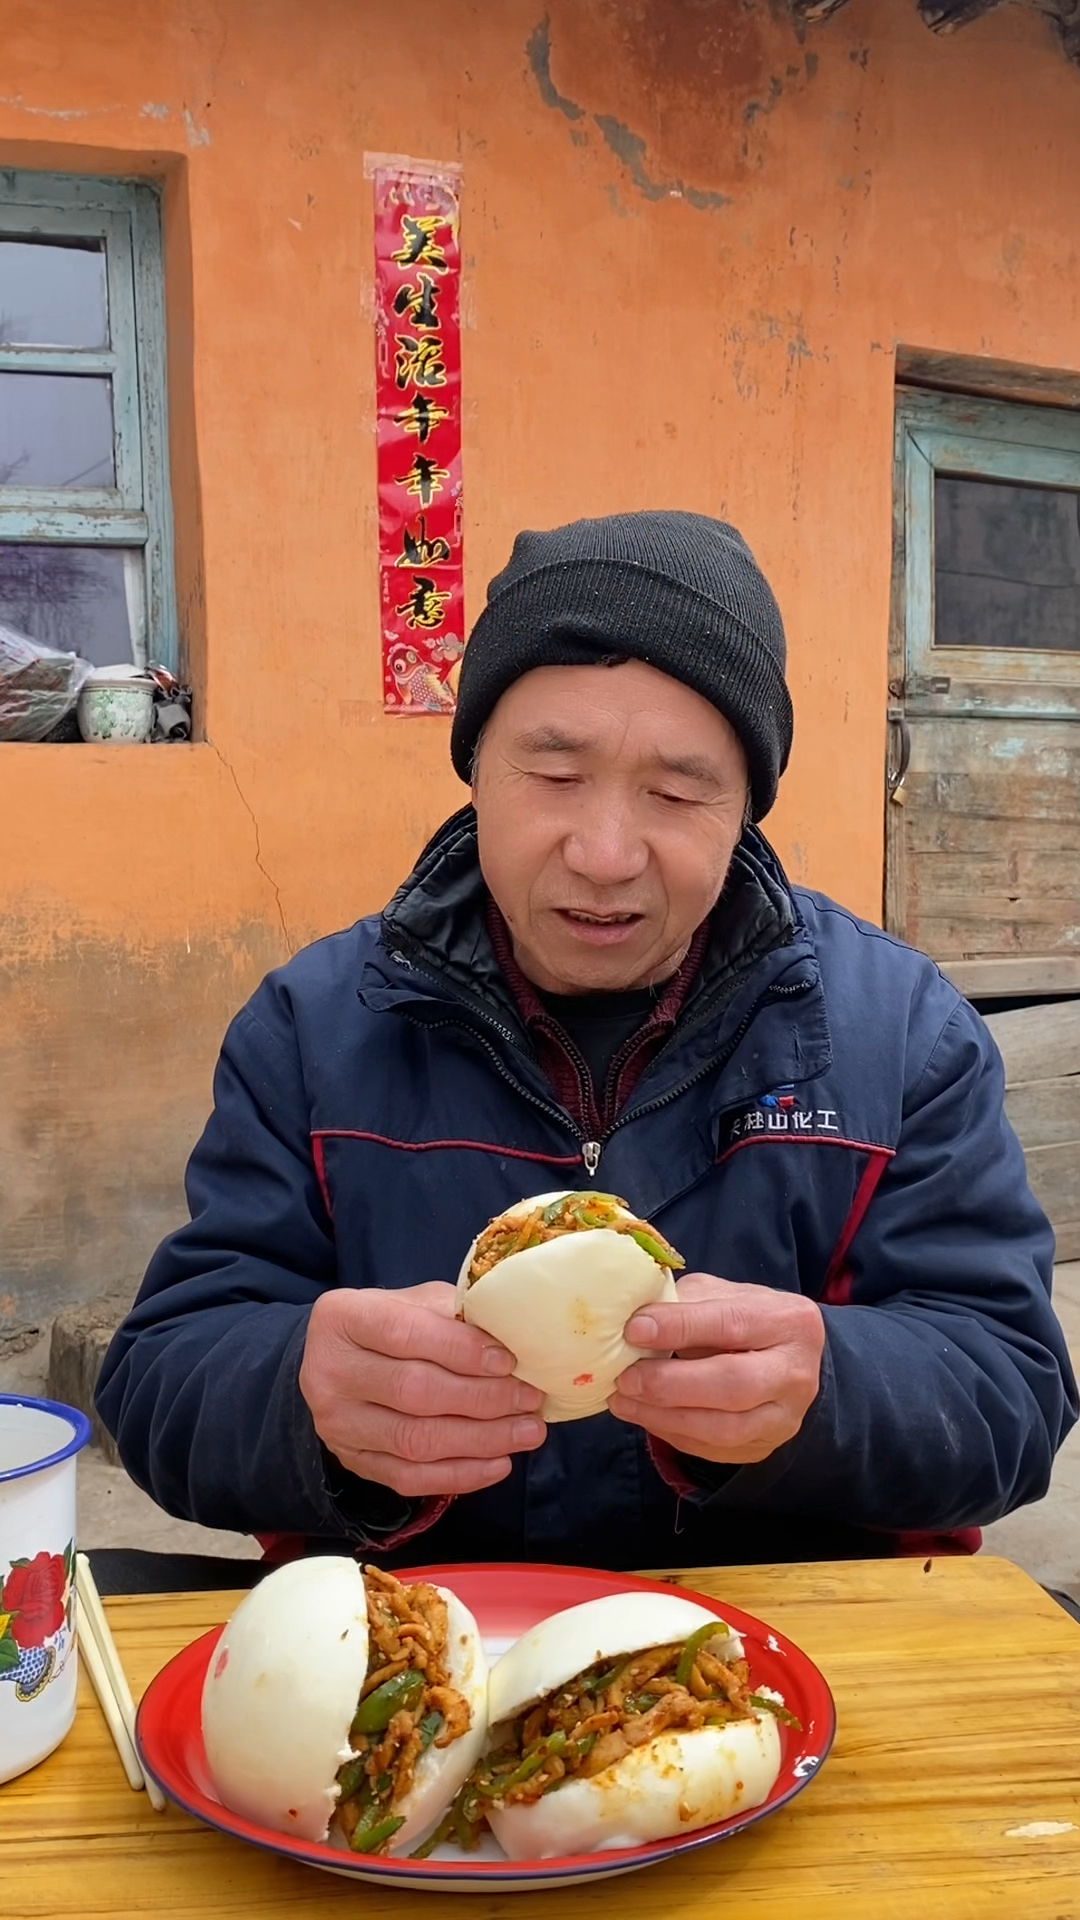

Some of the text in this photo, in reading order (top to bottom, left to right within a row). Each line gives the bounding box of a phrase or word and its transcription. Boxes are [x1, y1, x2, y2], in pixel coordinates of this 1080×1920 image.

[391, 214, 452, 630] 美生活年年如意
